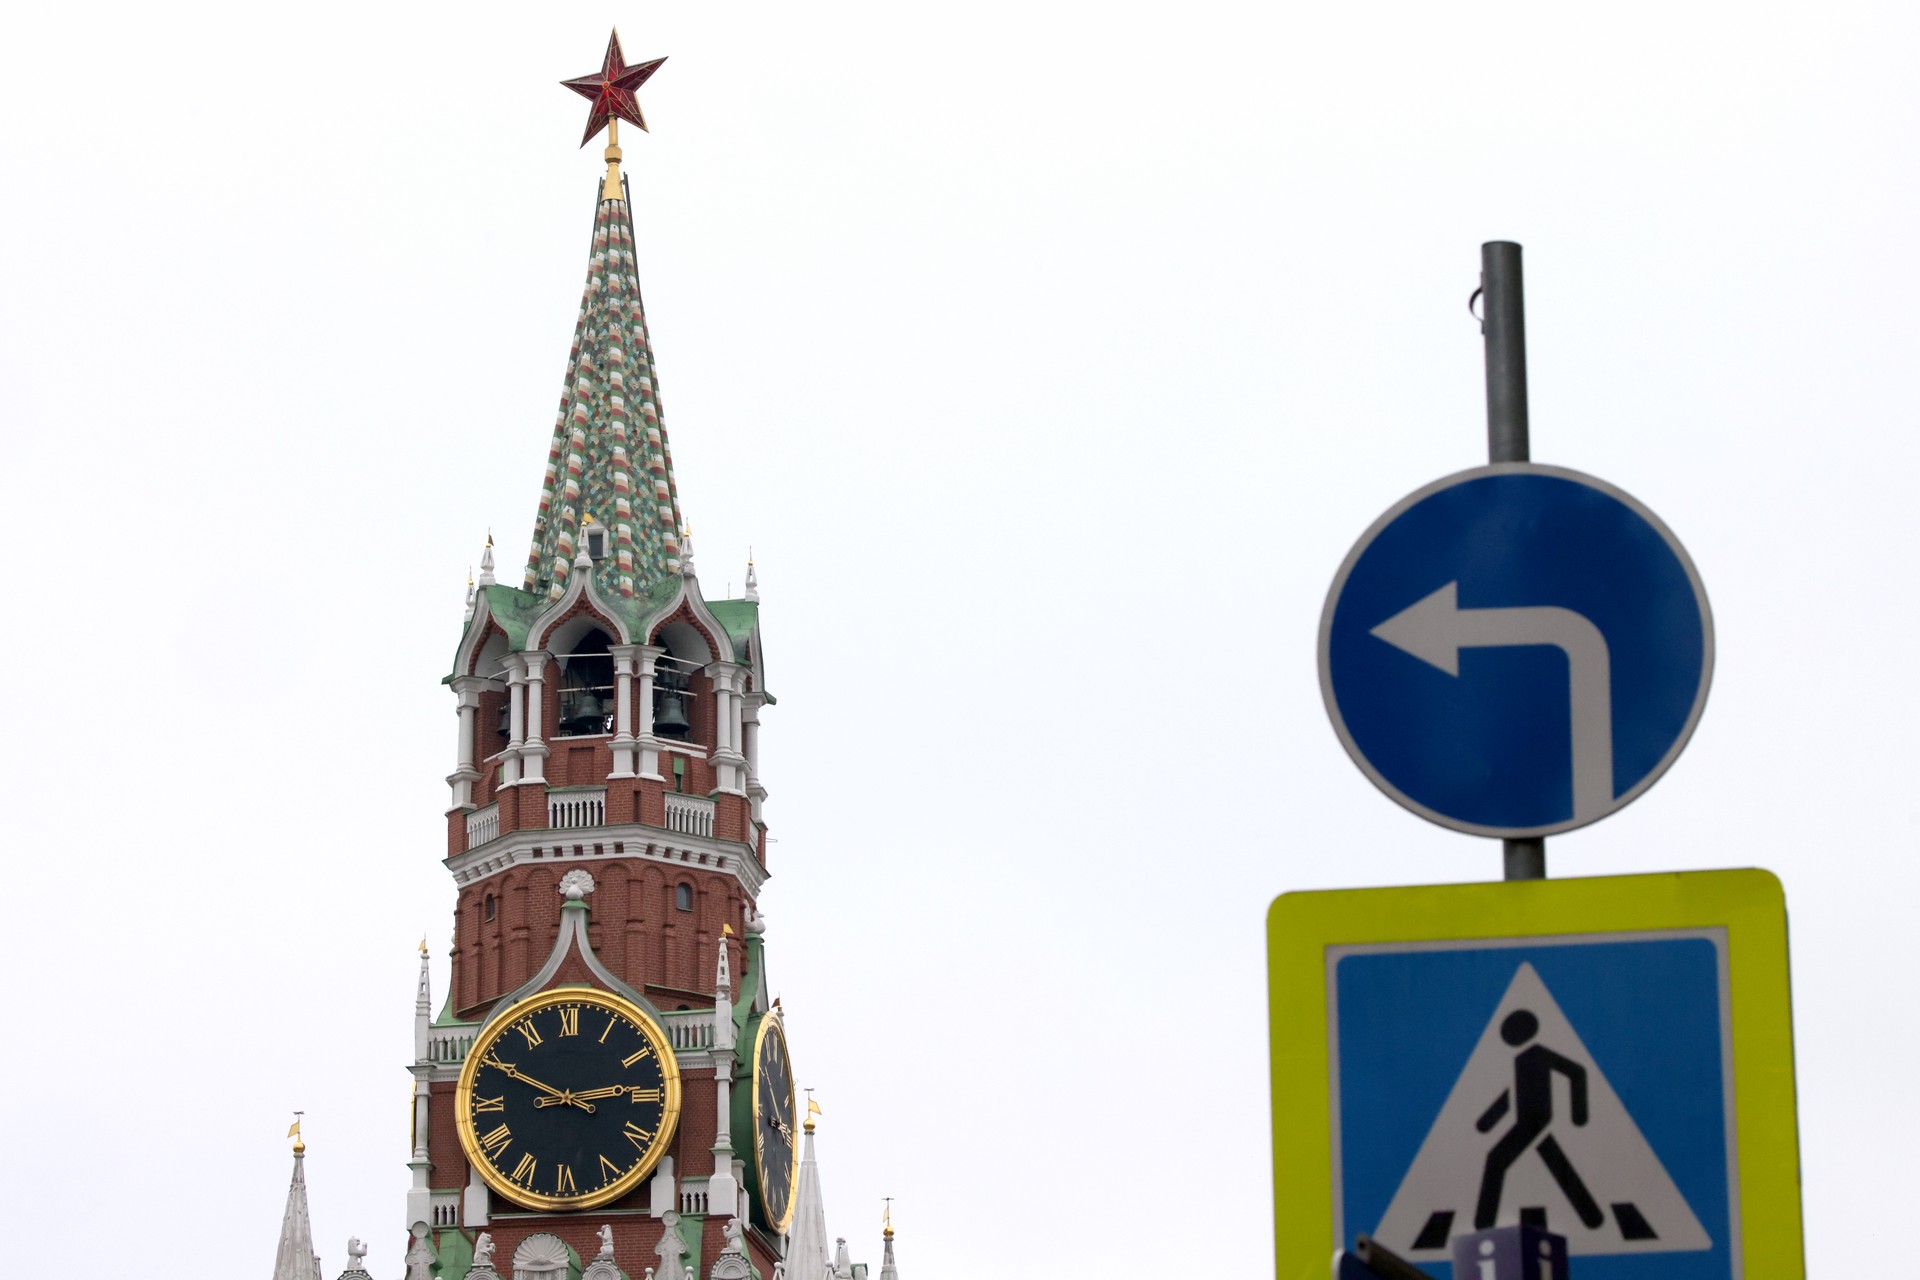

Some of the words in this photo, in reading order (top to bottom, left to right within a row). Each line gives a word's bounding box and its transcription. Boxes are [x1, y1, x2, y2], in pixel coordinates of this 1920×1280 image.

[516, 1019, 543, 1050] XI
[559, 1008, 579, 1037] XII
[598, 1017, 616, 1044] I
[621, 1046, 650, 1068] II
[476, 1095, 504, 1113] IX
[632, 1088, 660, 1103] III
[481, 1122, 513, 1160] VIII
[623, 1121, 651, 1152] IV
[511, 1152, 537, 1187] VII
[556, 1164, 577, 1192] VI
[599, 1154, 621, 1182] V
